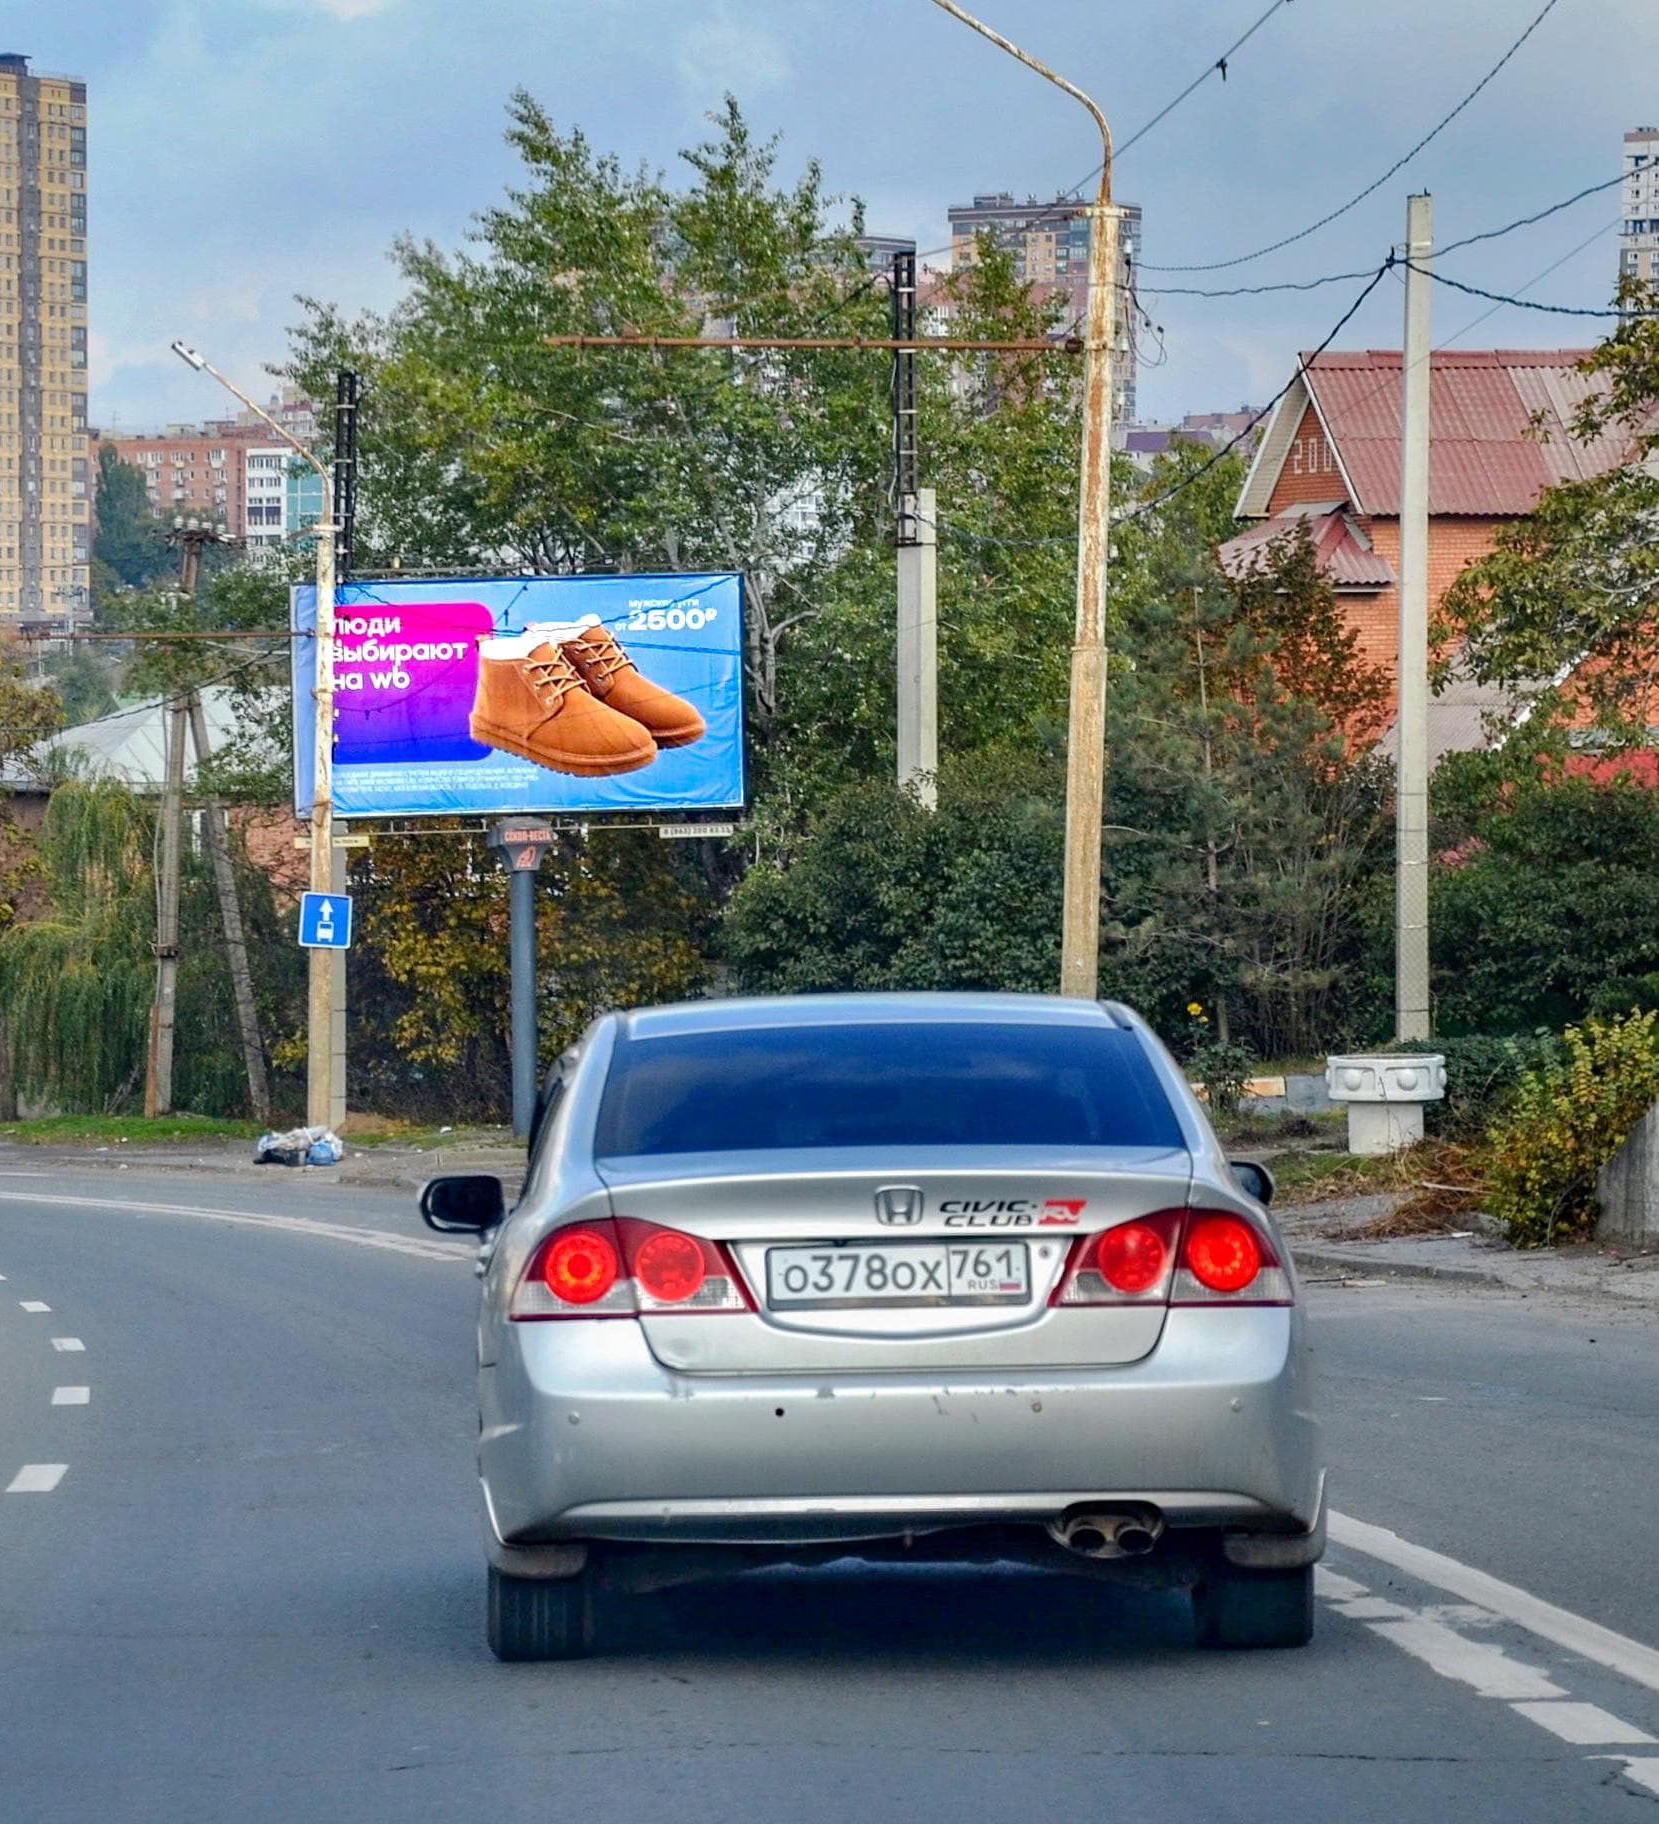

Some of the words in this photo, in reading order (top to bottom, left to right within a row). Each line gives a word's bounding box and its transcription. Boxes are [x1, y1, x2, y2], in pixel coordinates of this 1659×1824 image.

[332, 617, 401, 637] люди
[332, 639, 468, 666] выбирают
[370, 666, 410, 689] wb
[944, 1214, 1033, 1227] CLUB
[951, 1249, 1012, 1279] 761
[967, 1279, 997, 1291] RUS
